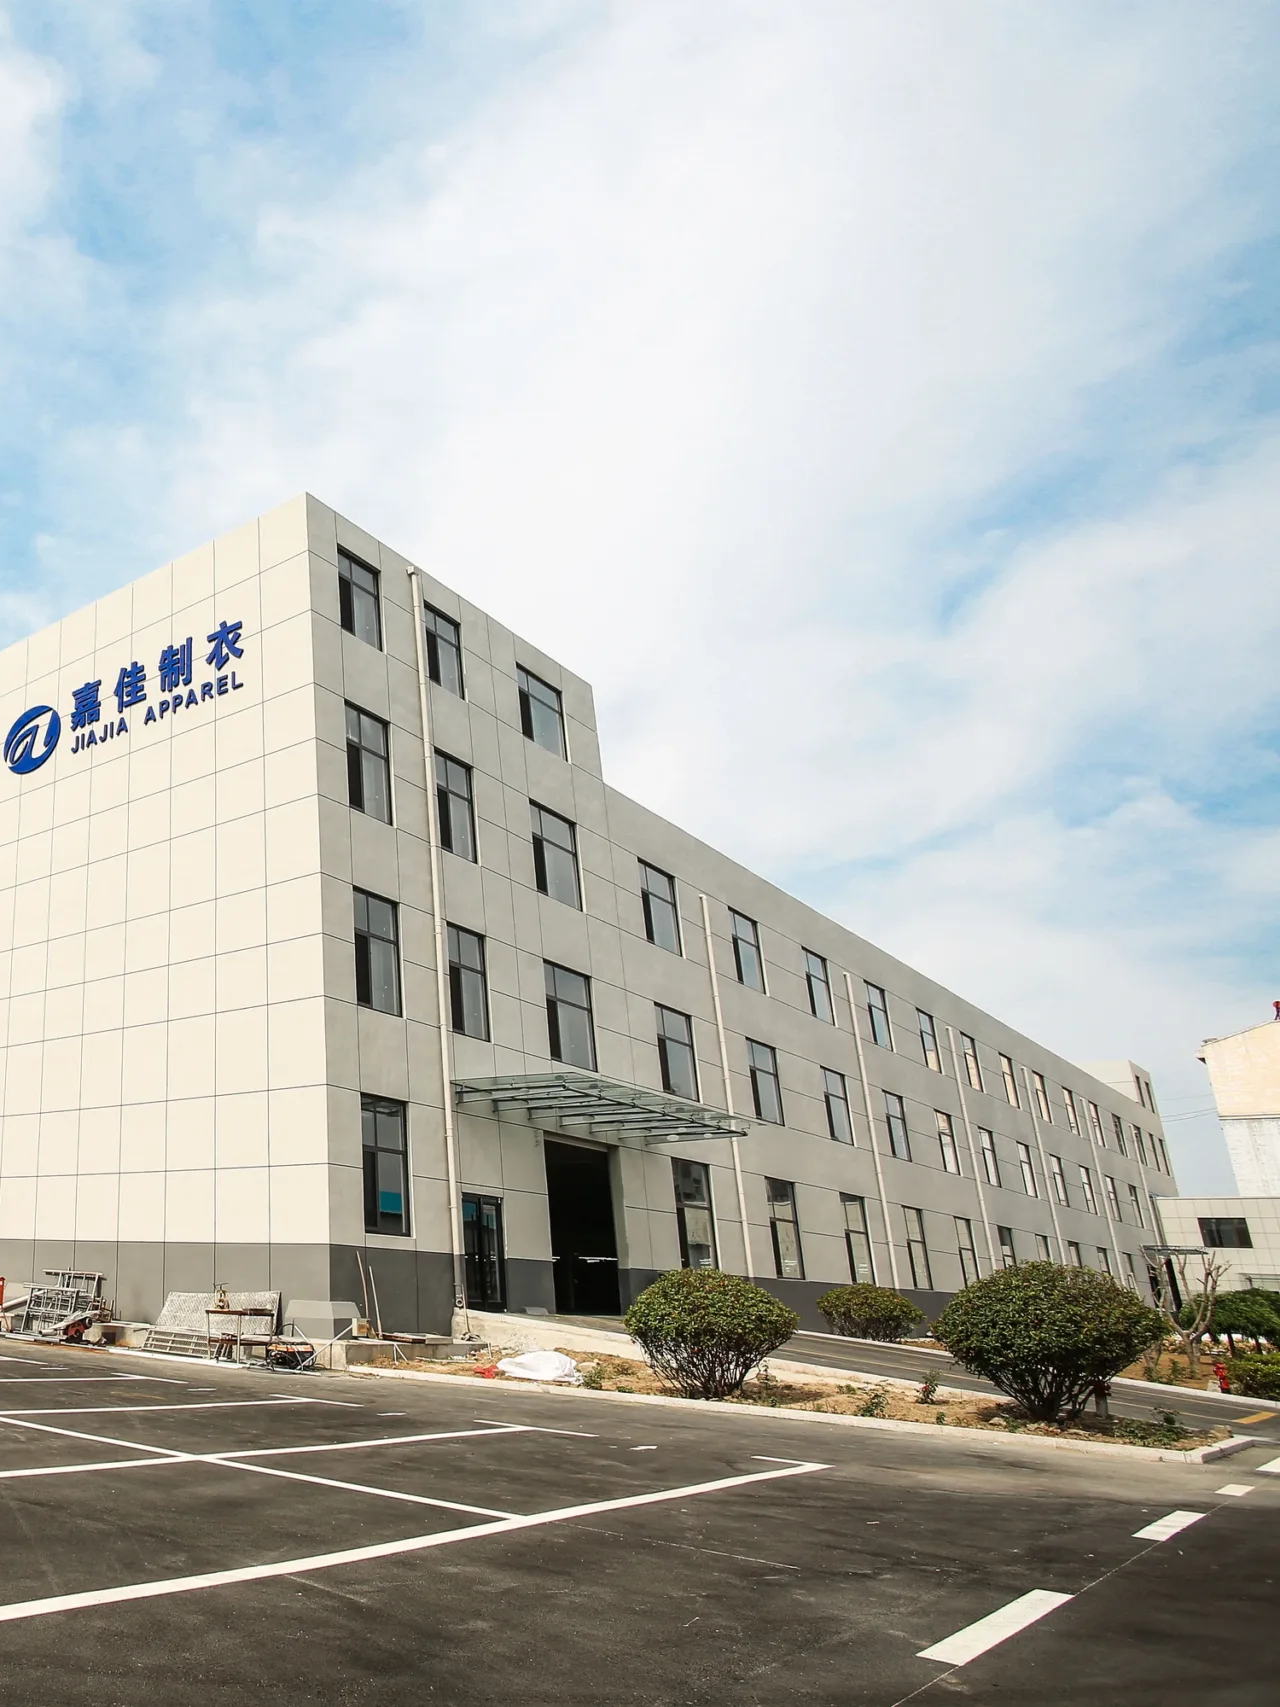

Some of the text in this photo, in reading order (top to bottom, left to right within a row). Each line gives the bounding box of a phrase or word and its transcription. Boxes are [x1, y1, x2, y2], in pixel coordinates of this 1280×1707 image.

[70, 620, 244, 731] 嘉佳制衣
[71, 671, 244, 754] JIAJIA APPAREL
